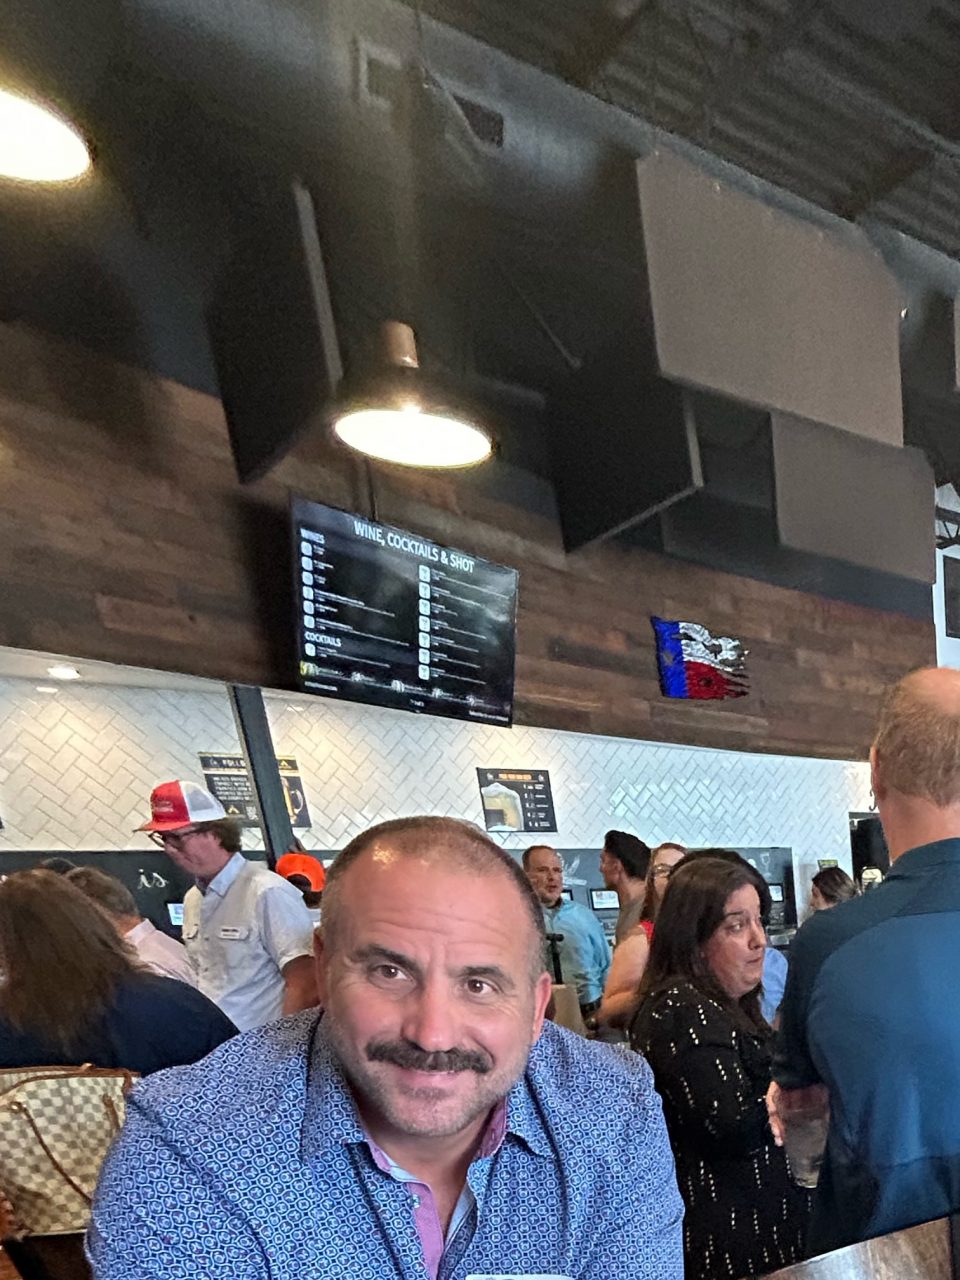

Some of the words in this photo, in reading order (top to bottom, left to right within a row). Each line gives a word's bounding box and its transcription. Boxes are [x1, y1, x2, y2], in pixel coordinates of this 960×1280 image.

[354, 520, 386, 546] WINE,
[387, 532, 439, 562] COCKTAILS
[440, 550, 449, 566] &
[450, 554, 475, 573] SHOT
[304, 631, 342, 647] COCKTAILS
[137, 868, 169, 890] is
